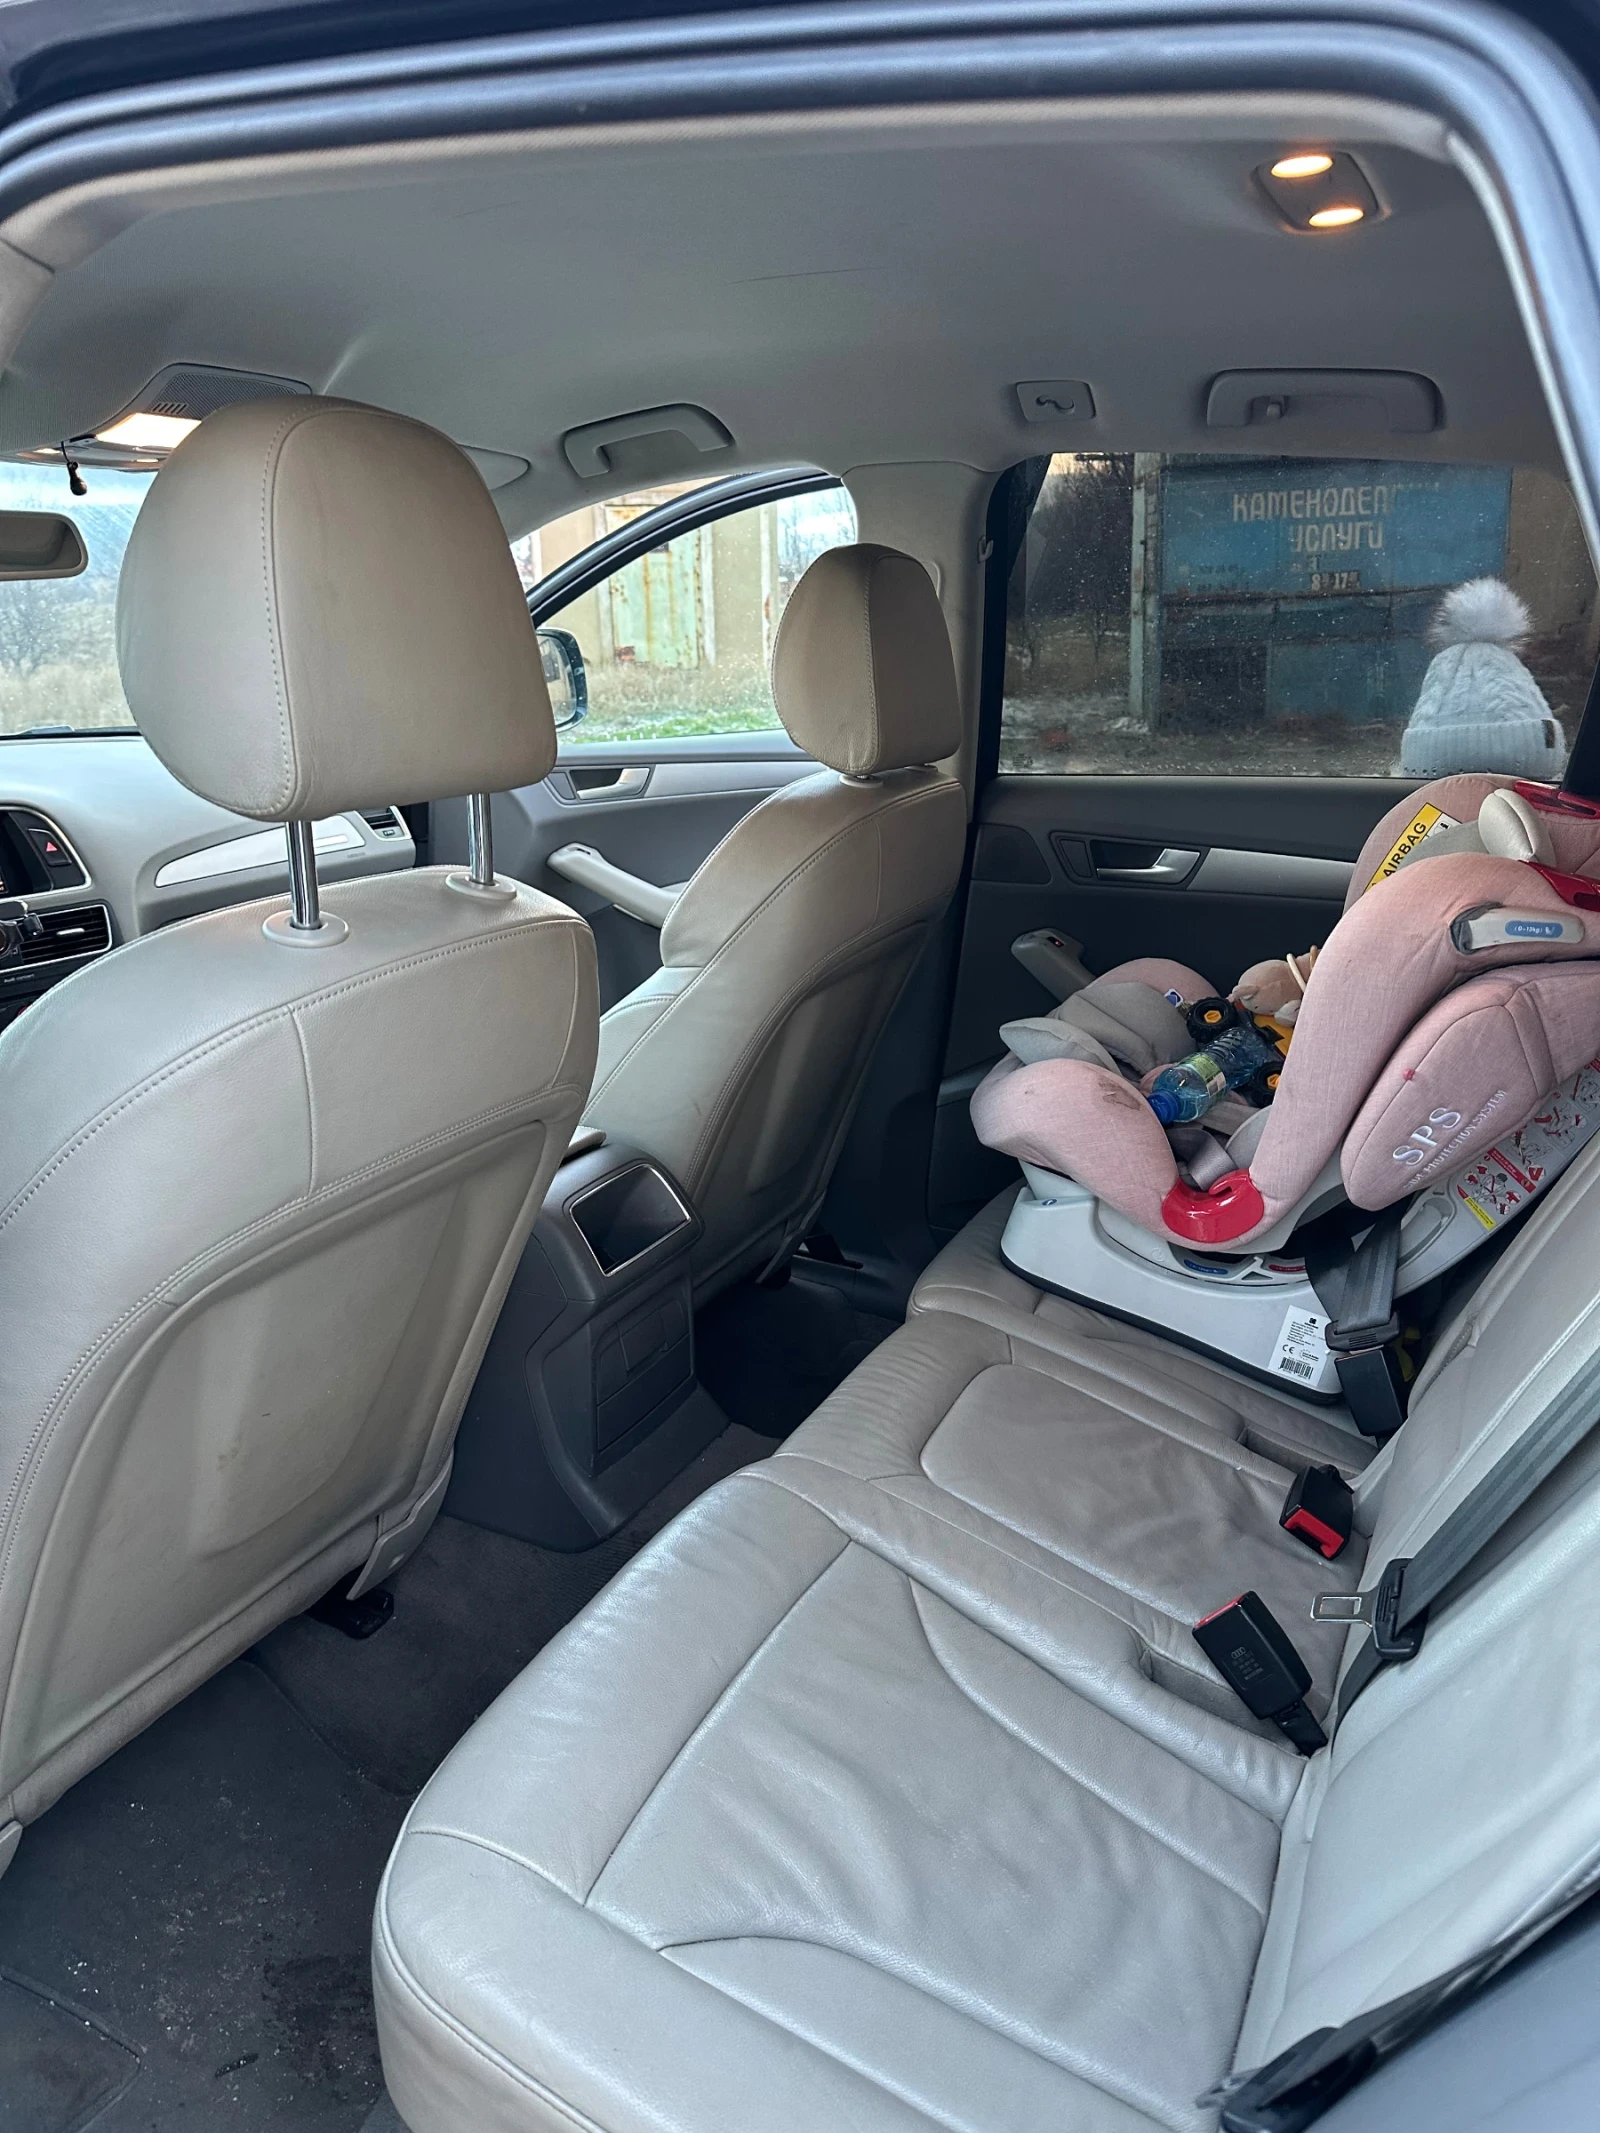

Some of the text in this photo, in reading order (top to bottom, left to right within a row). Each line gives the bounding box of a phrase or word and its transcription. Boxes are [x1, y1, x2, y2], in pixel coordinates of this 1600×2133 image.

[1289, 521, 1384, 553] УСЛУГИ
[1383, 822, 1427, 877] AIRBAG
[1471, 1089, 1507, 1124] SYSTEM
[1392, 1107, 1461, 1167] SPS
